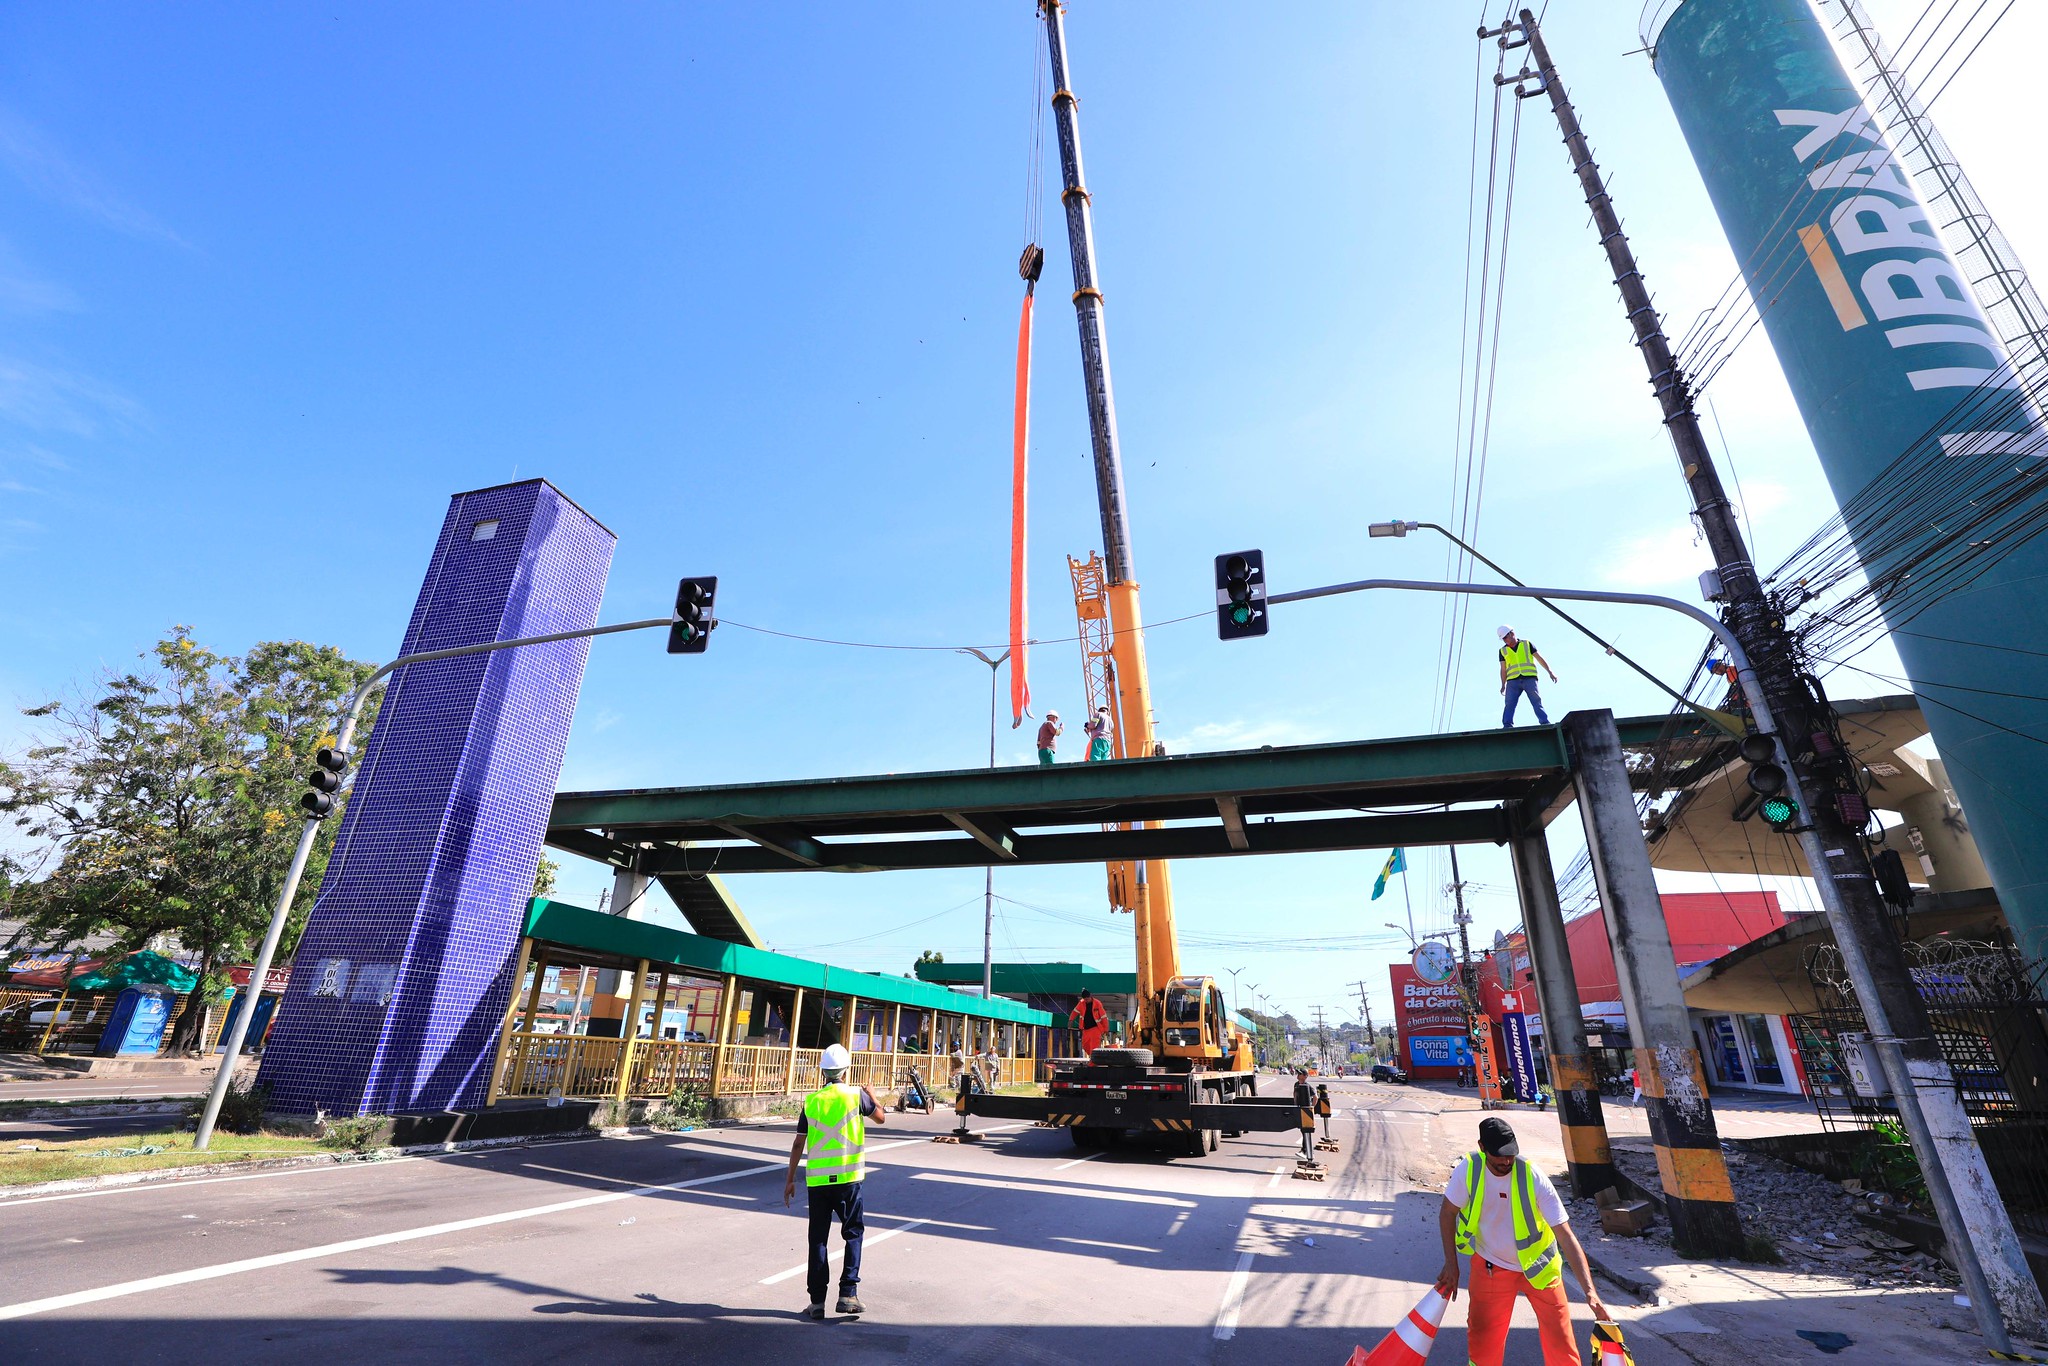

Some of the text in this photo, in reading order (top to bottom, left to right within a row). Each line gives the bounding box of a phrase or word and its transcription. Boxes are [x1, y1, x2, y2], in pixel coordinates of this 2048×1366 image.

[10, 953, 73, 971] Locad
[1403, 984, 1459, 997] Baratã
[1405, 997, 1463, 1009] da Carn
[1413, 1015, 1440, 1026] barato
[1415, 1040, 1448, 1049] Bonna
[1426, 1049, 1448, 1059] Vitta
[1510, 1017, 1530, 1099] PagueMenos
